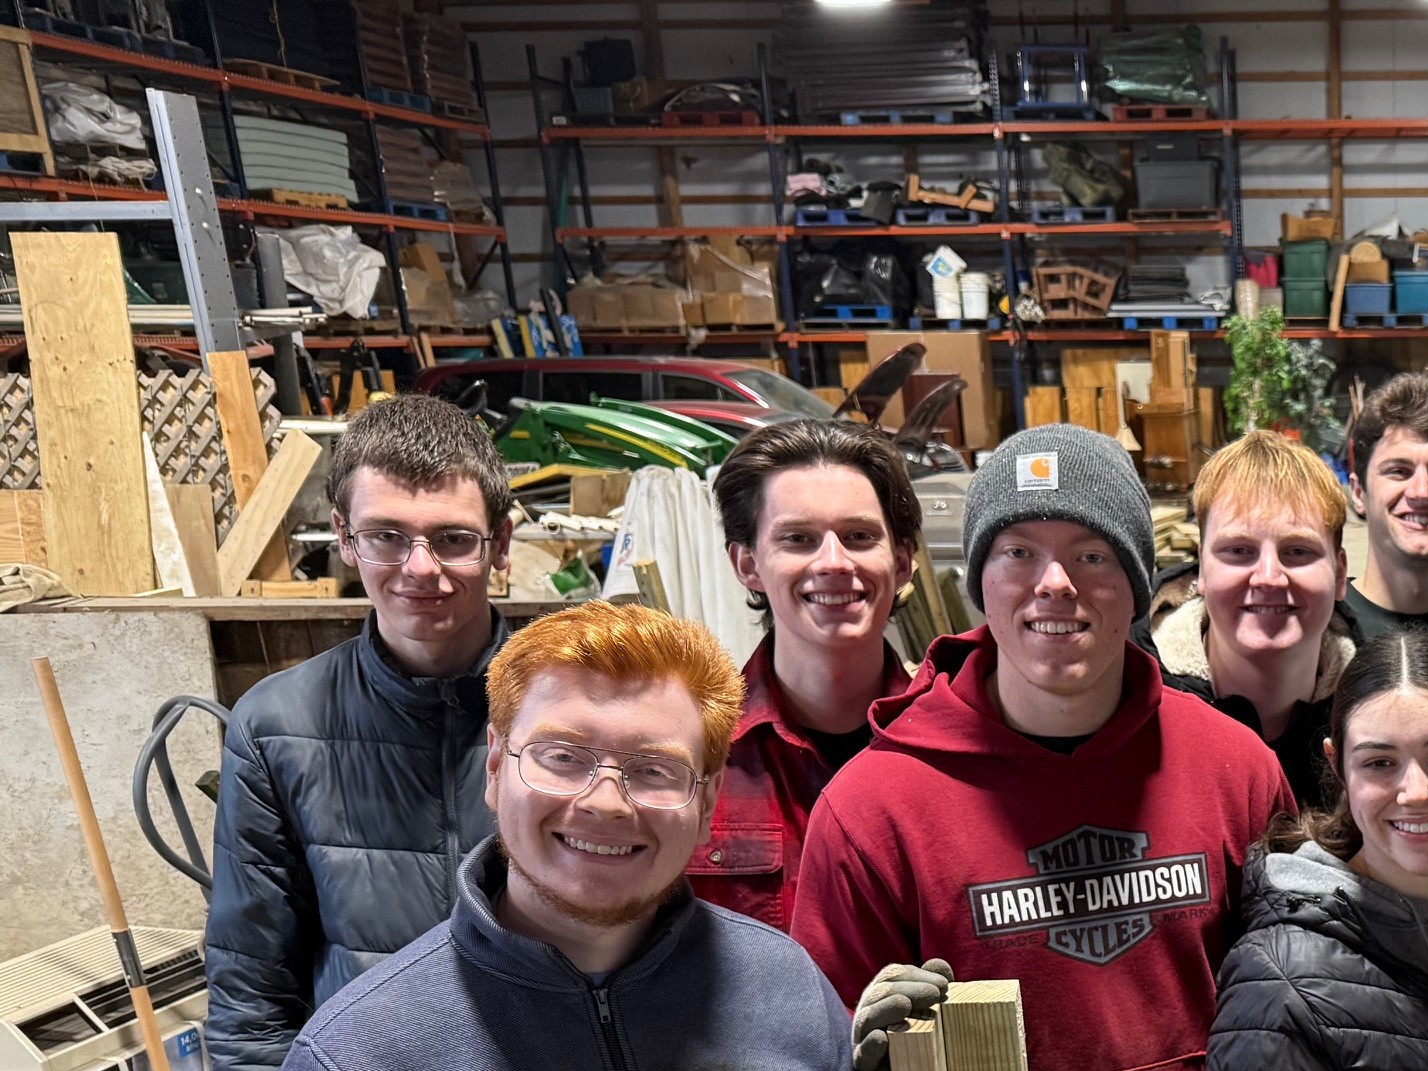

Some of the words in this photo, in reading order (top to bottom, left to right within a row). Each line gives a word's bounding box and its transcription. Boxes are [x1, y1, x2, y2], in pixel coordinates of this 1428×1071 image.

[1038, 829, 1138, 872] MOTOR
[981, 862, 1202, 927] HARLEY-DAVIDSON
[1054, 916, 1146, 958] CYCLES
